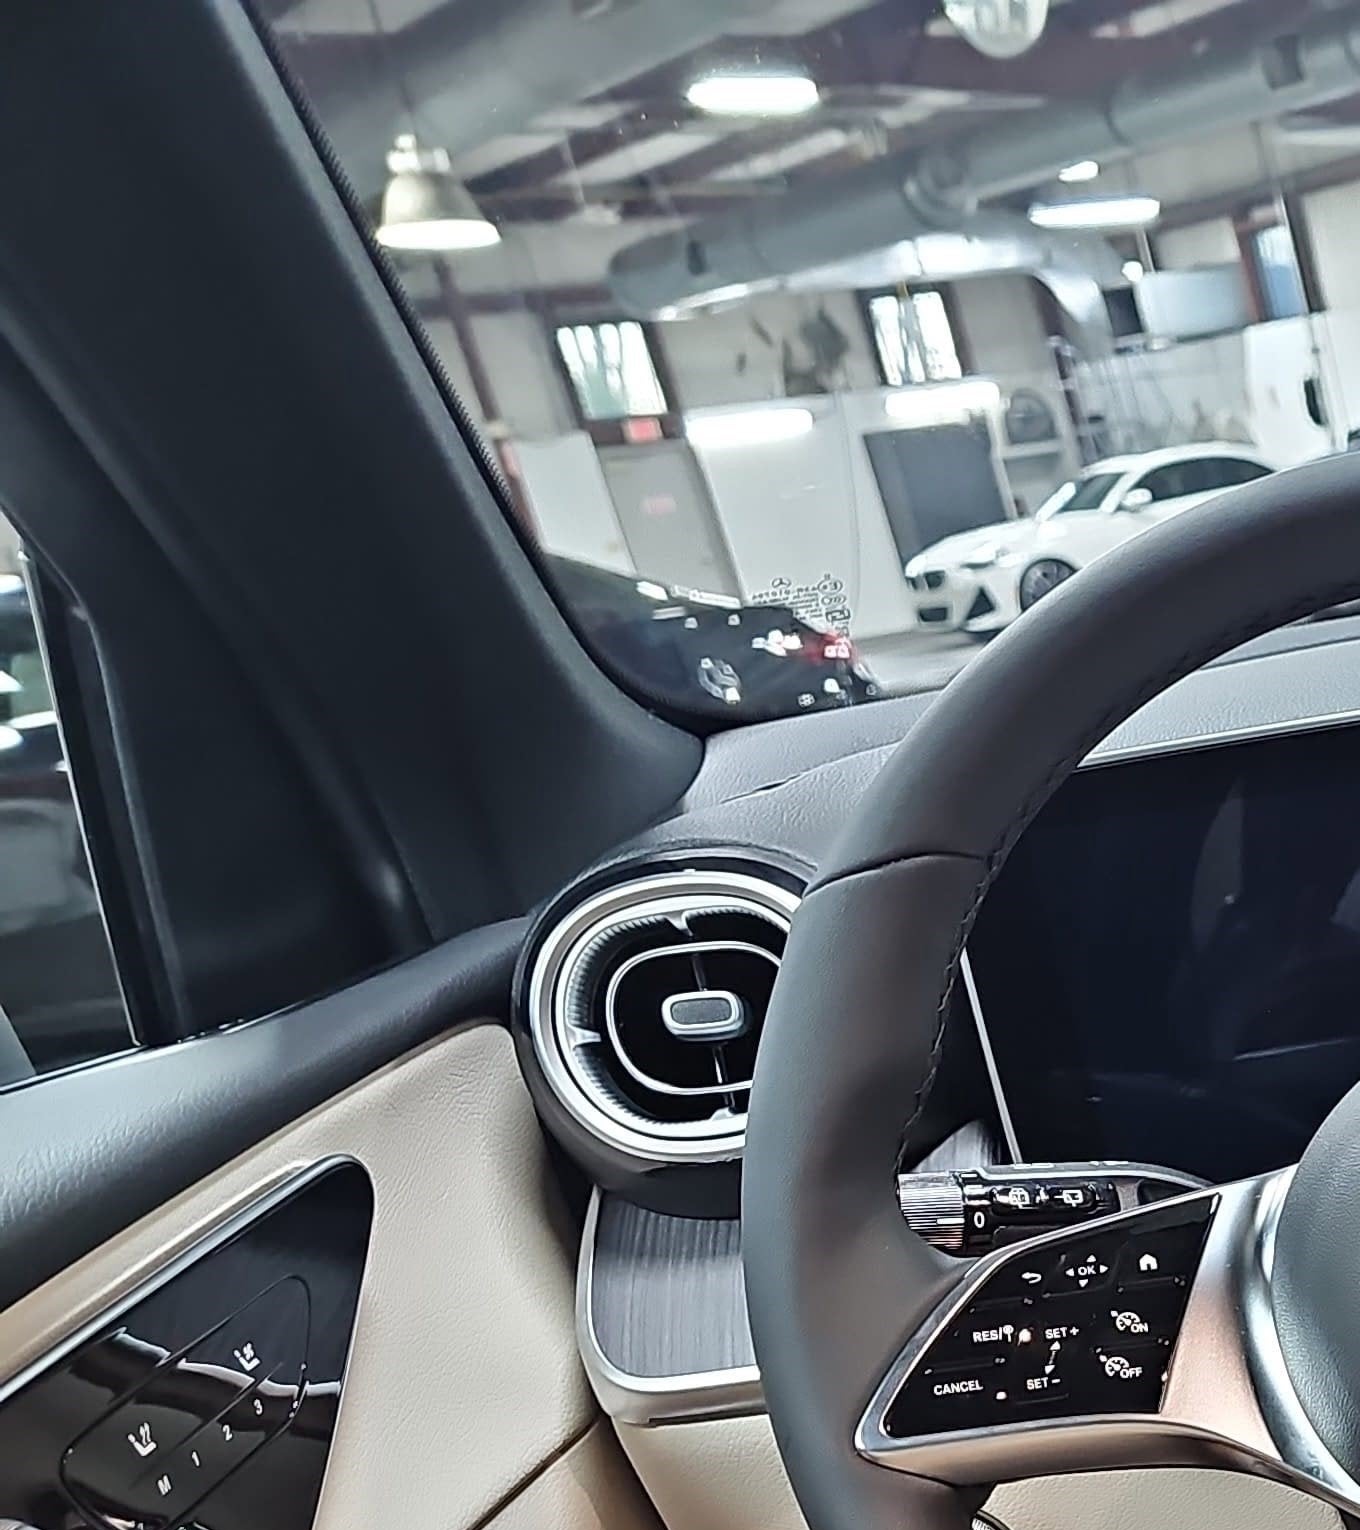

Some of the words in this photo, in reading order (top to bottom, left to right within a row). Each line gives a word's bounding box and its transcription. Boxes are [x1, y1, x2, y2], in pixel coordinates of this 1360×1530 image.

[1077, 1264, 1096, 1276] OK
[1044, 1326, 1068, 1340] SET
[1130, 1322, 1149, 1333] ON
[1119, 1366, 1143, 1379] OFF
[933, 1380, 984, 1396] CANCEL
[1026, 1377, 1049, 1391] SET
[253, 1399, 263, 1415] 3
[222, 1424, 233, 1441] 2
[191, 1451, 200, 1467] 1
[158, 1474, 172, 1496] M
